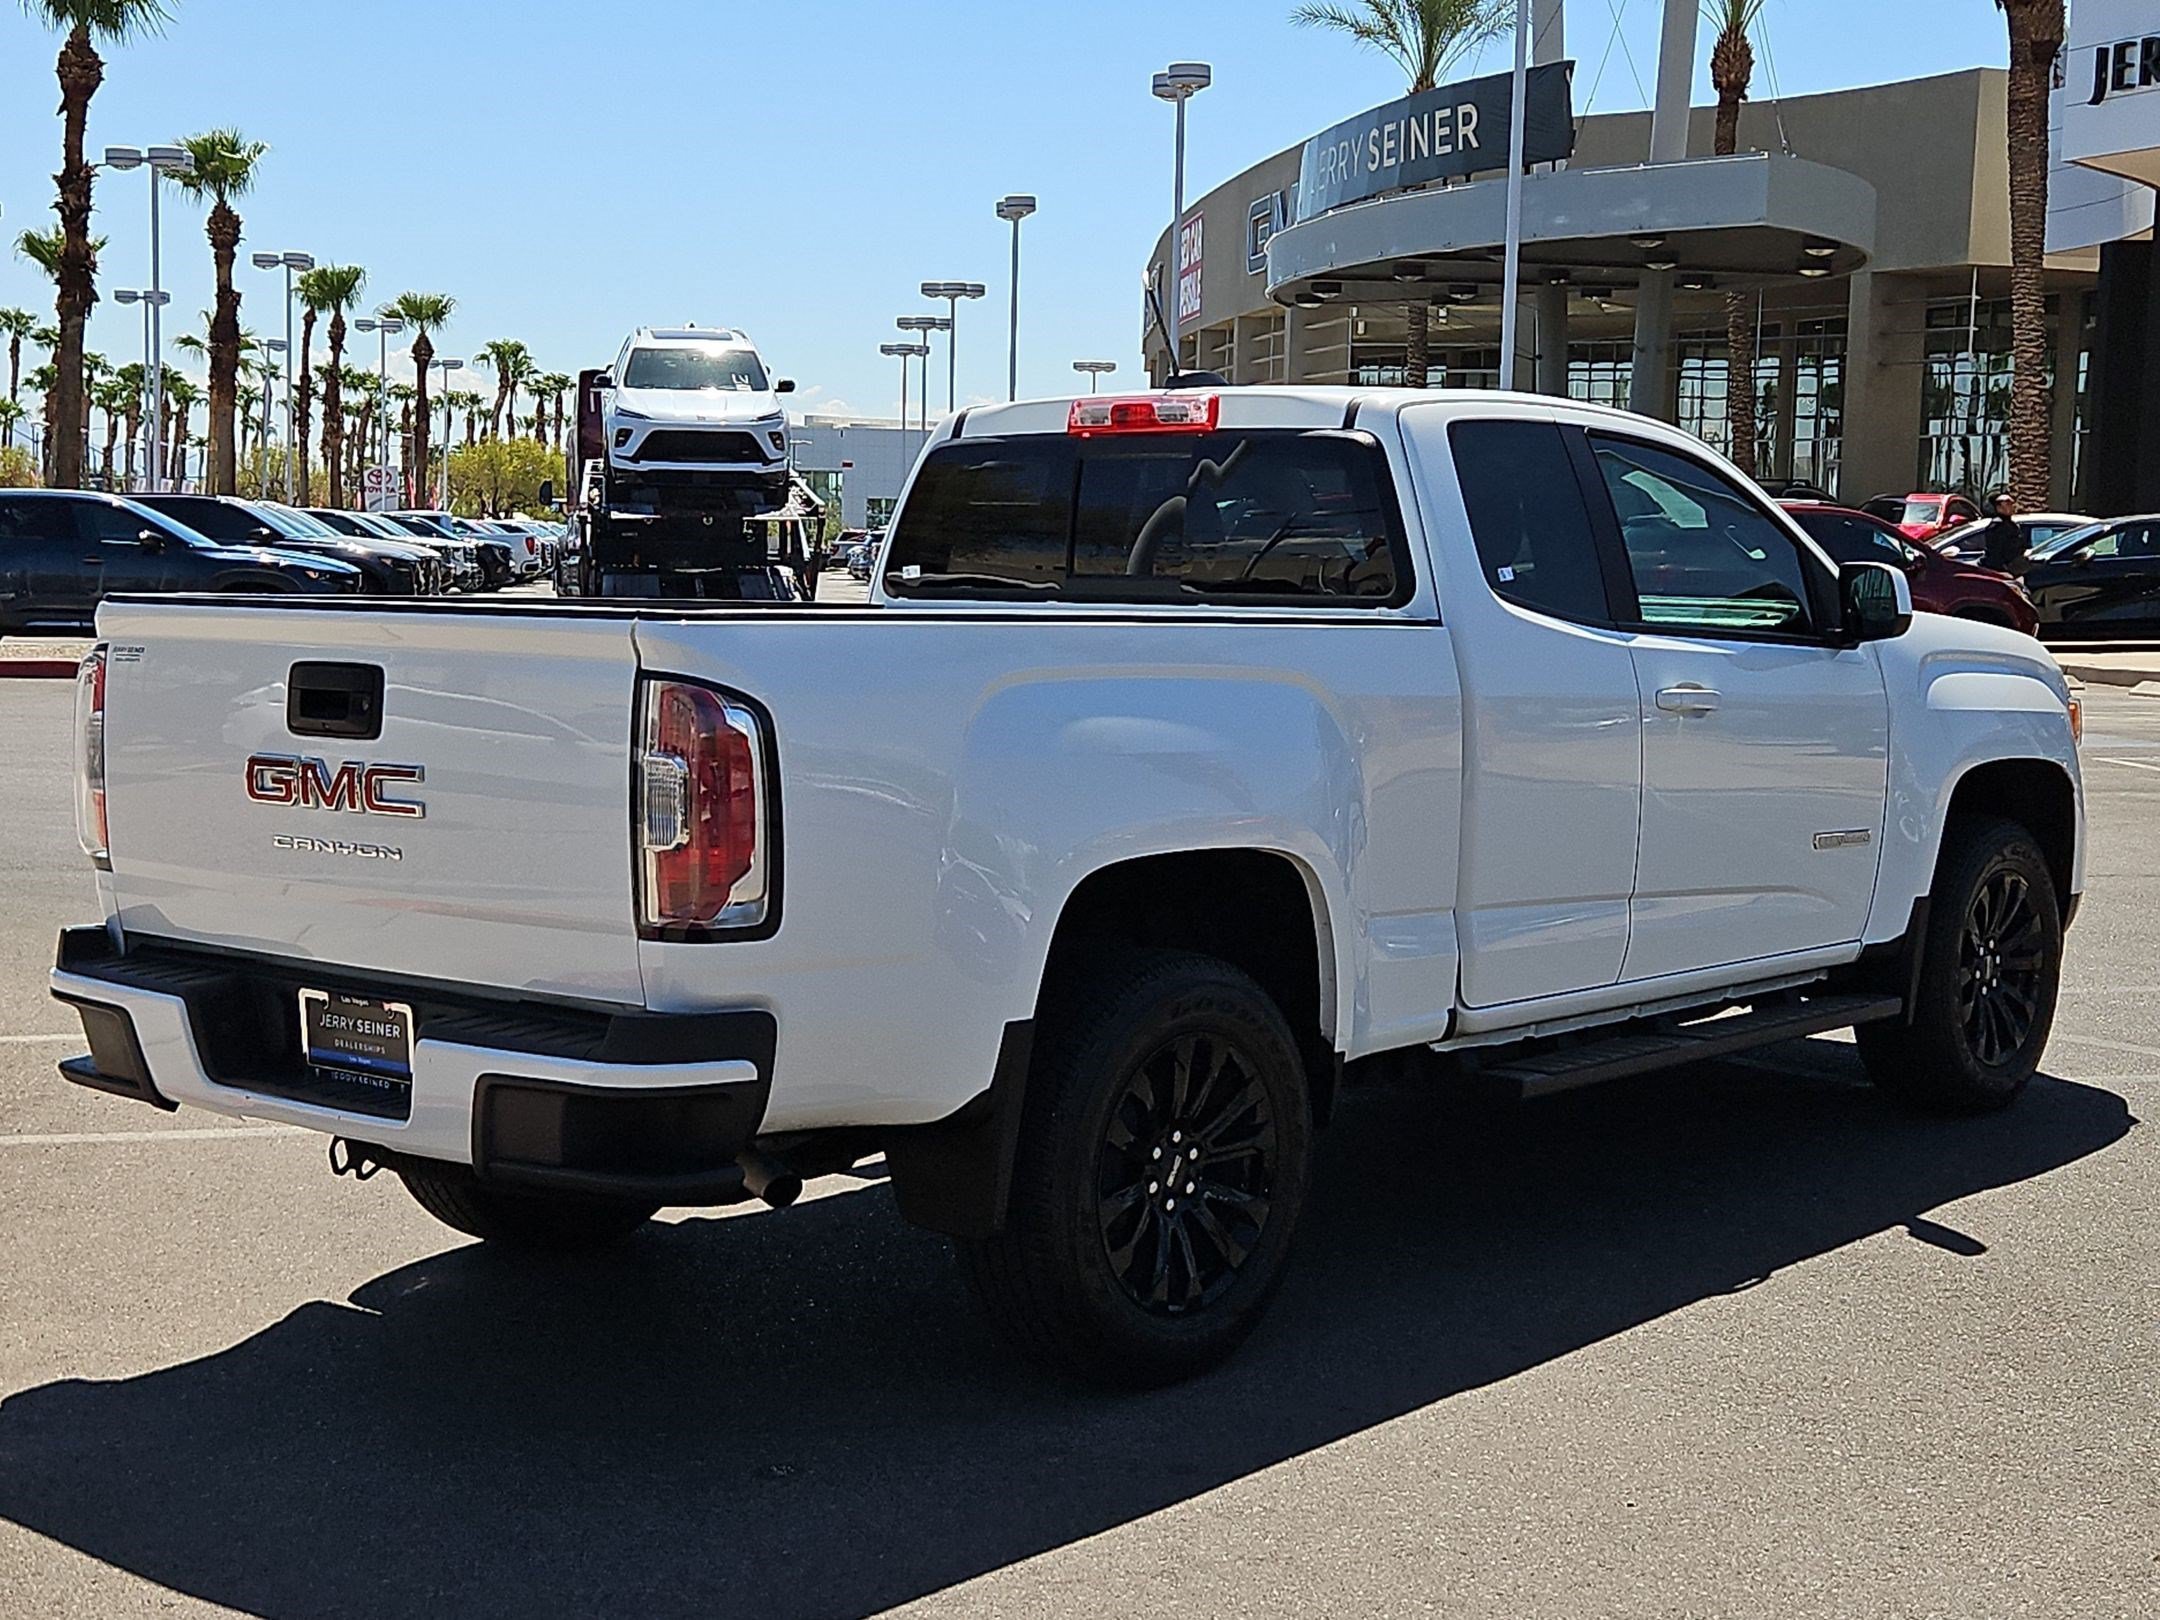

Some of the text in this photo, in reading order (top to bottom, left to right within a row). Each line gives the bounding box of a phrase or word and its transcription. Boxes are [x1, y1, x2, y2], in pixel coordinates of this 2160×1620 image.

[1367, 103, 1480, 172] SEINER
[246, 752, 425, 818] GMC
[273, 834, 402, 860] CANYON
[320, 1013, 401, 1038] JERRY SEINER
[334, 1038, 386, 1054] DEALERSHIPS
